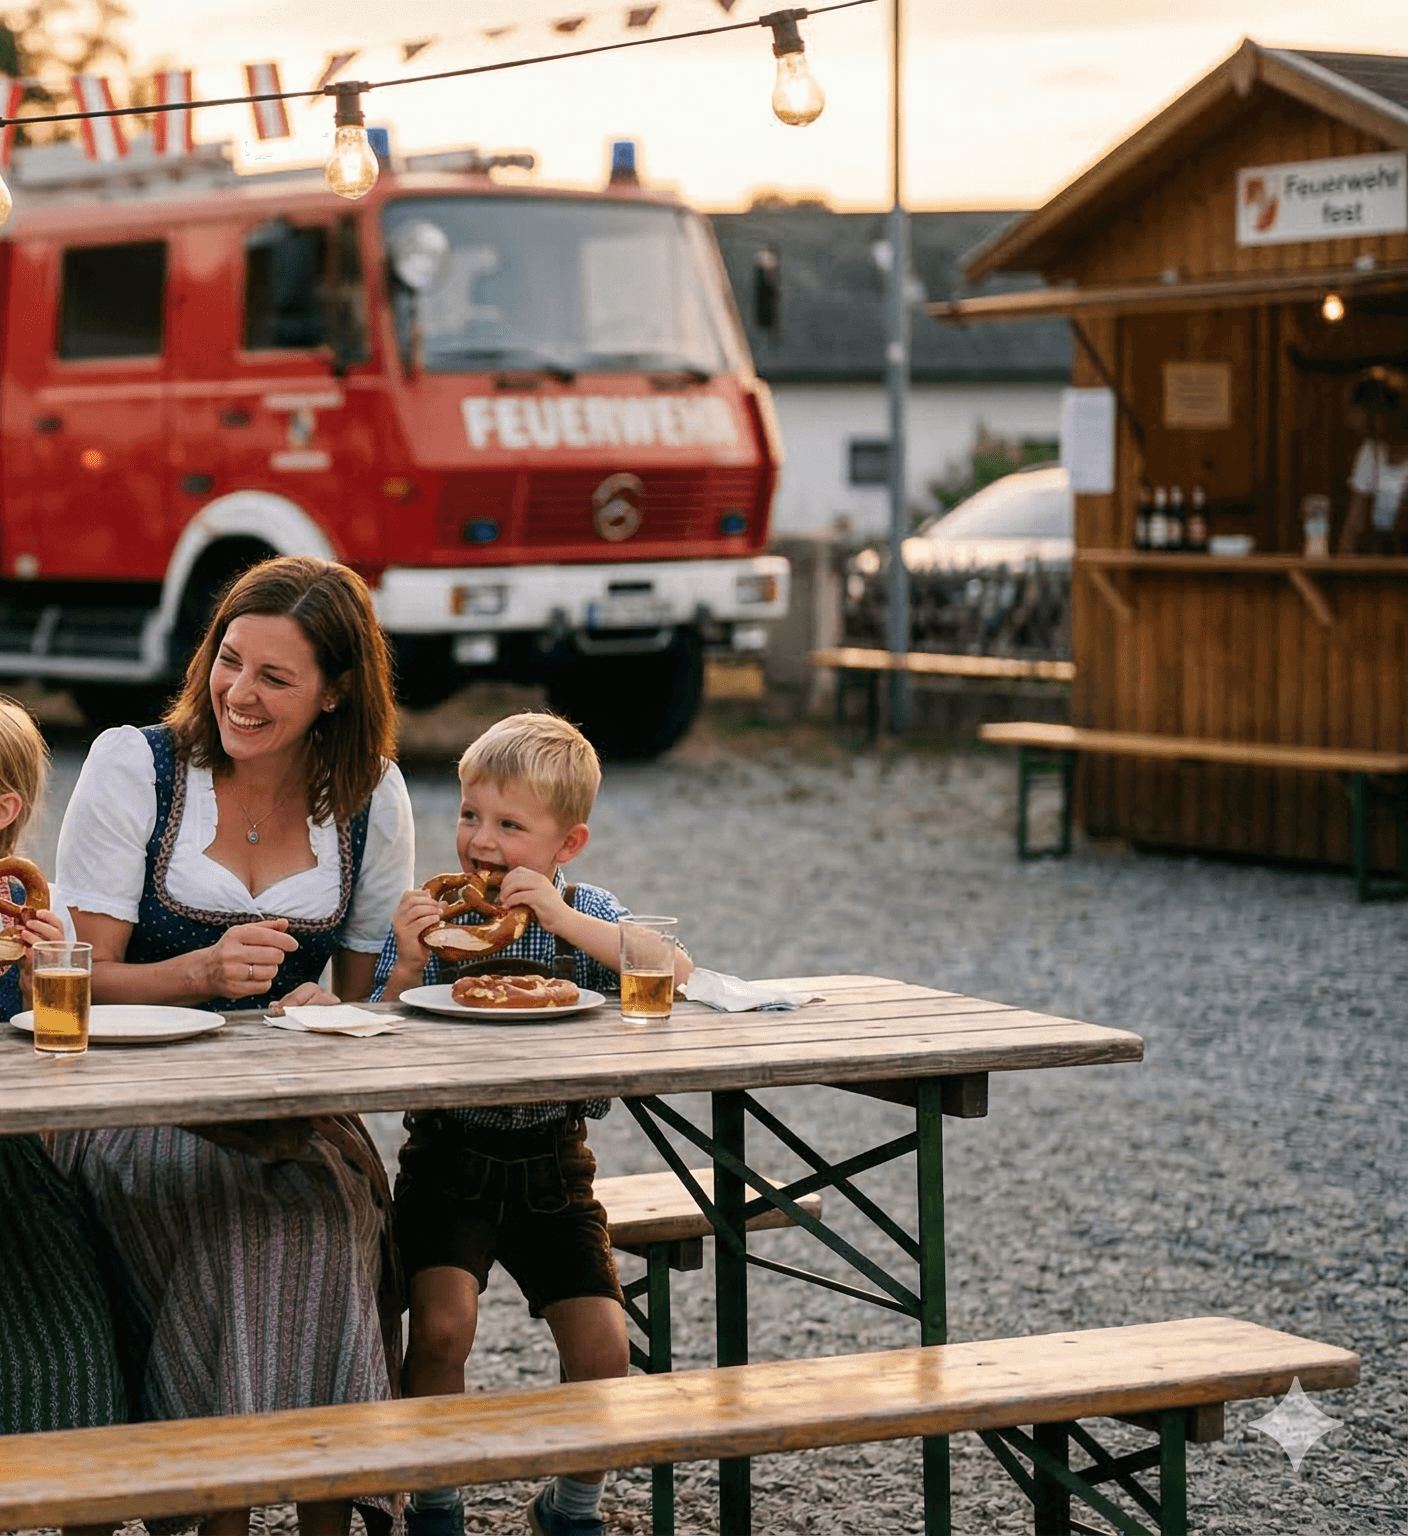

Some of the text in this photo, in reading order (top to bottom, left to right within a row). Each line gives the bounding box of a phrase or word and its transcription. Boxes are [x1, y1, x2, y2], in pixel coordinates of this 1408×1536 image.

[1284, 165, 1399, 199] Feuerwehr
[1322, 201, 1362, 224] fest
[463, 396, 737, 449] FEUERWEHR
